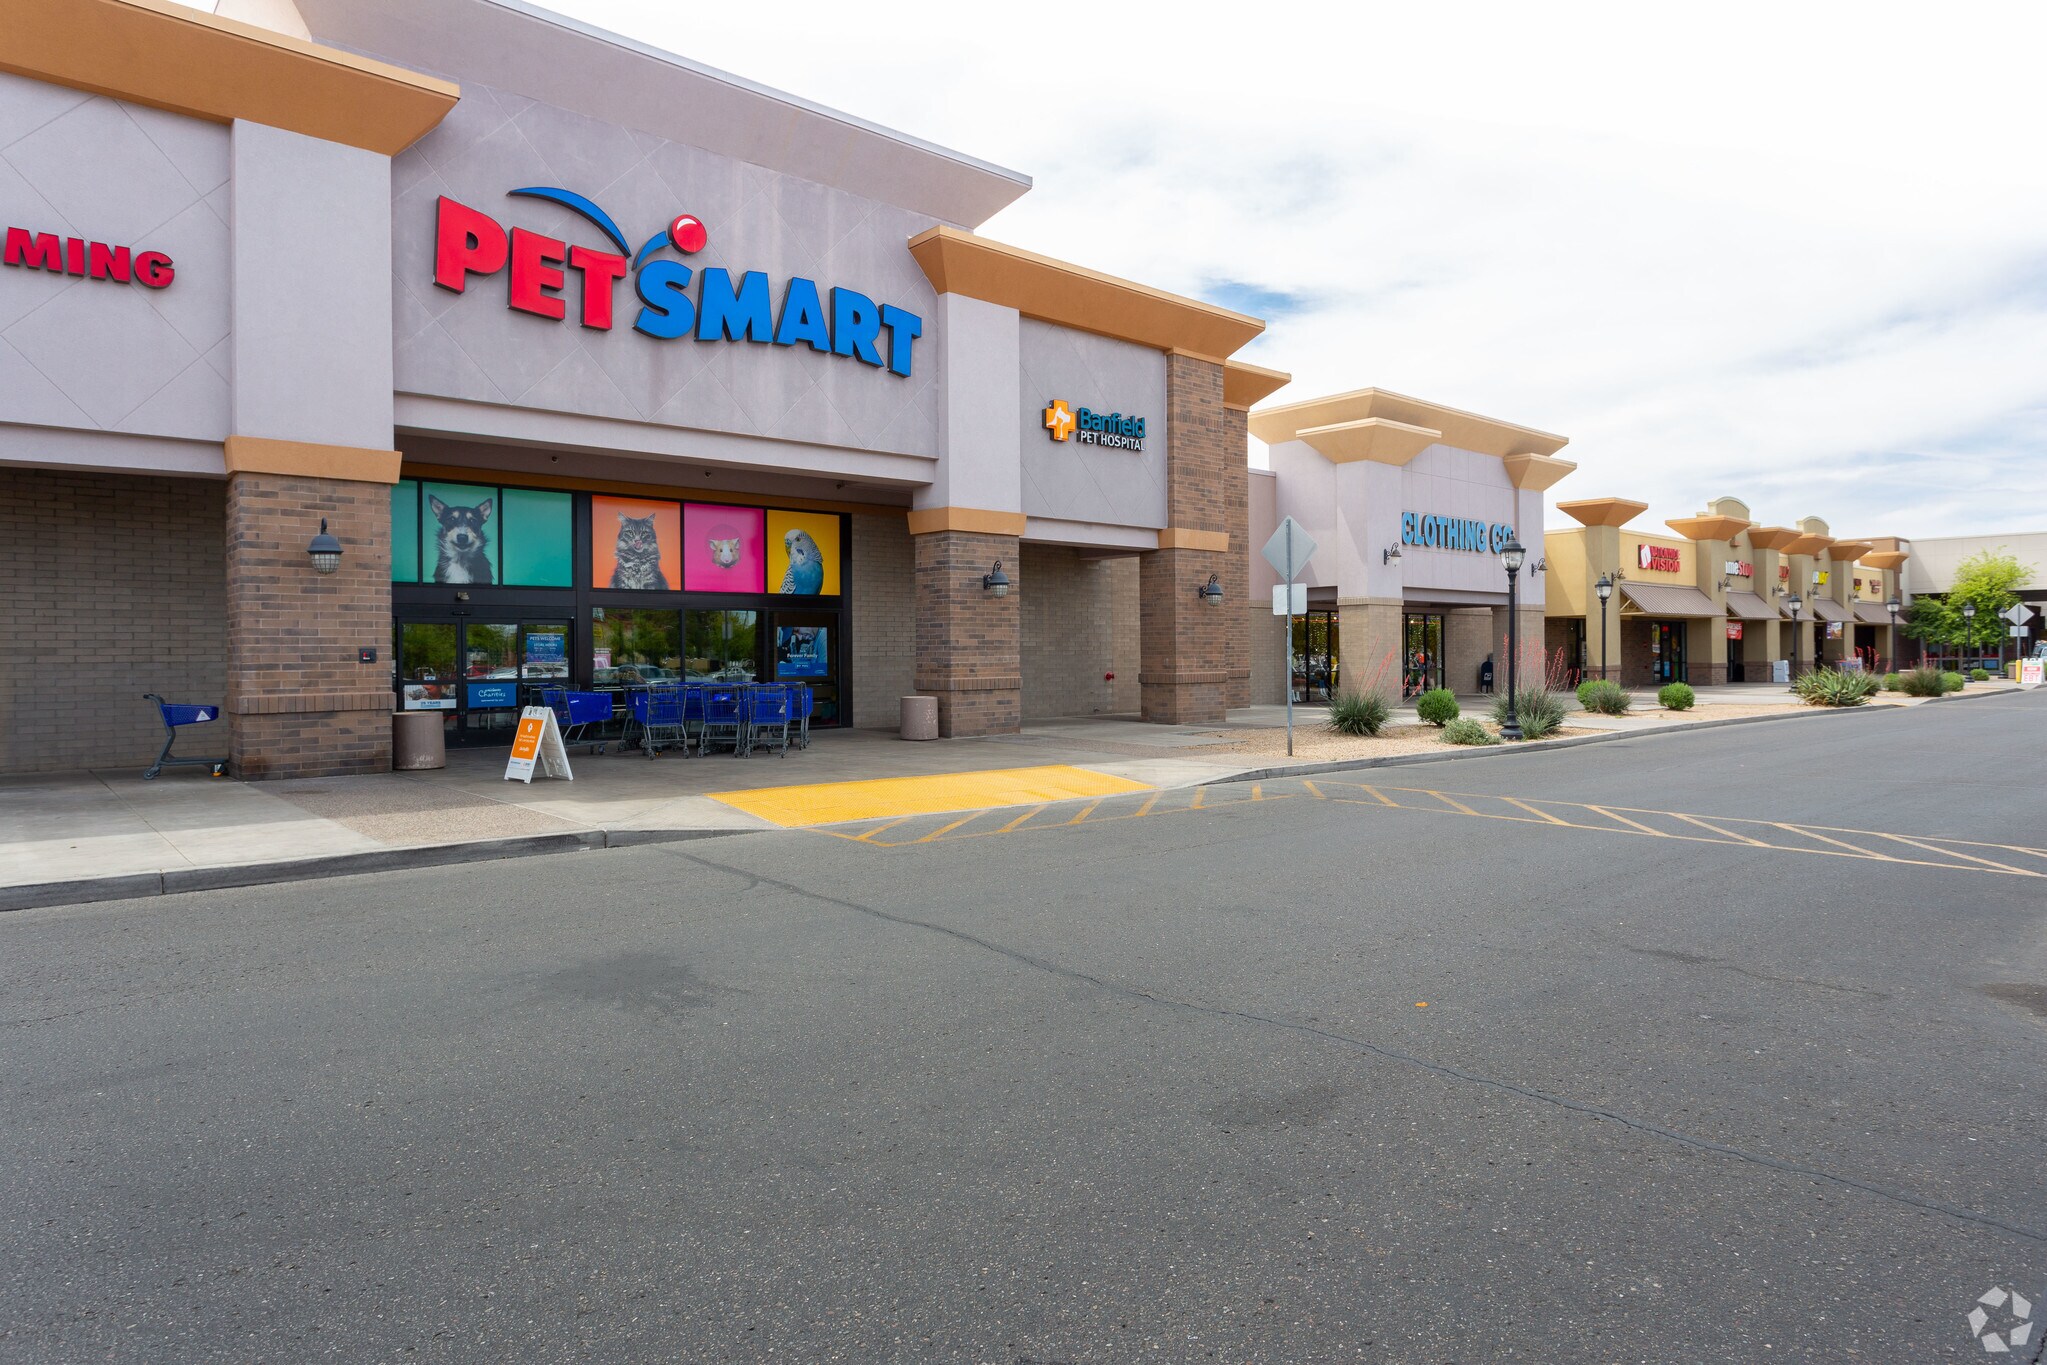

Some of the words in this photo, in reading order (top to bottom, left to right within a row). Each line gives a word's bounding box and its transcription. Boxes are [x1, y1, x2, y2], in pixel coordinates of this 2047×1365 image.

[3, 226, 175, 290] MING
[1077, 407, 1146, 439] Banfield
[1079, 430, 1099, 445] PET
[1100, 432, 1146, 451] HOSPITAL
[1401, 511, 1488, 554] CLOTHING
[1651, 557, 1680, 573] VISION
